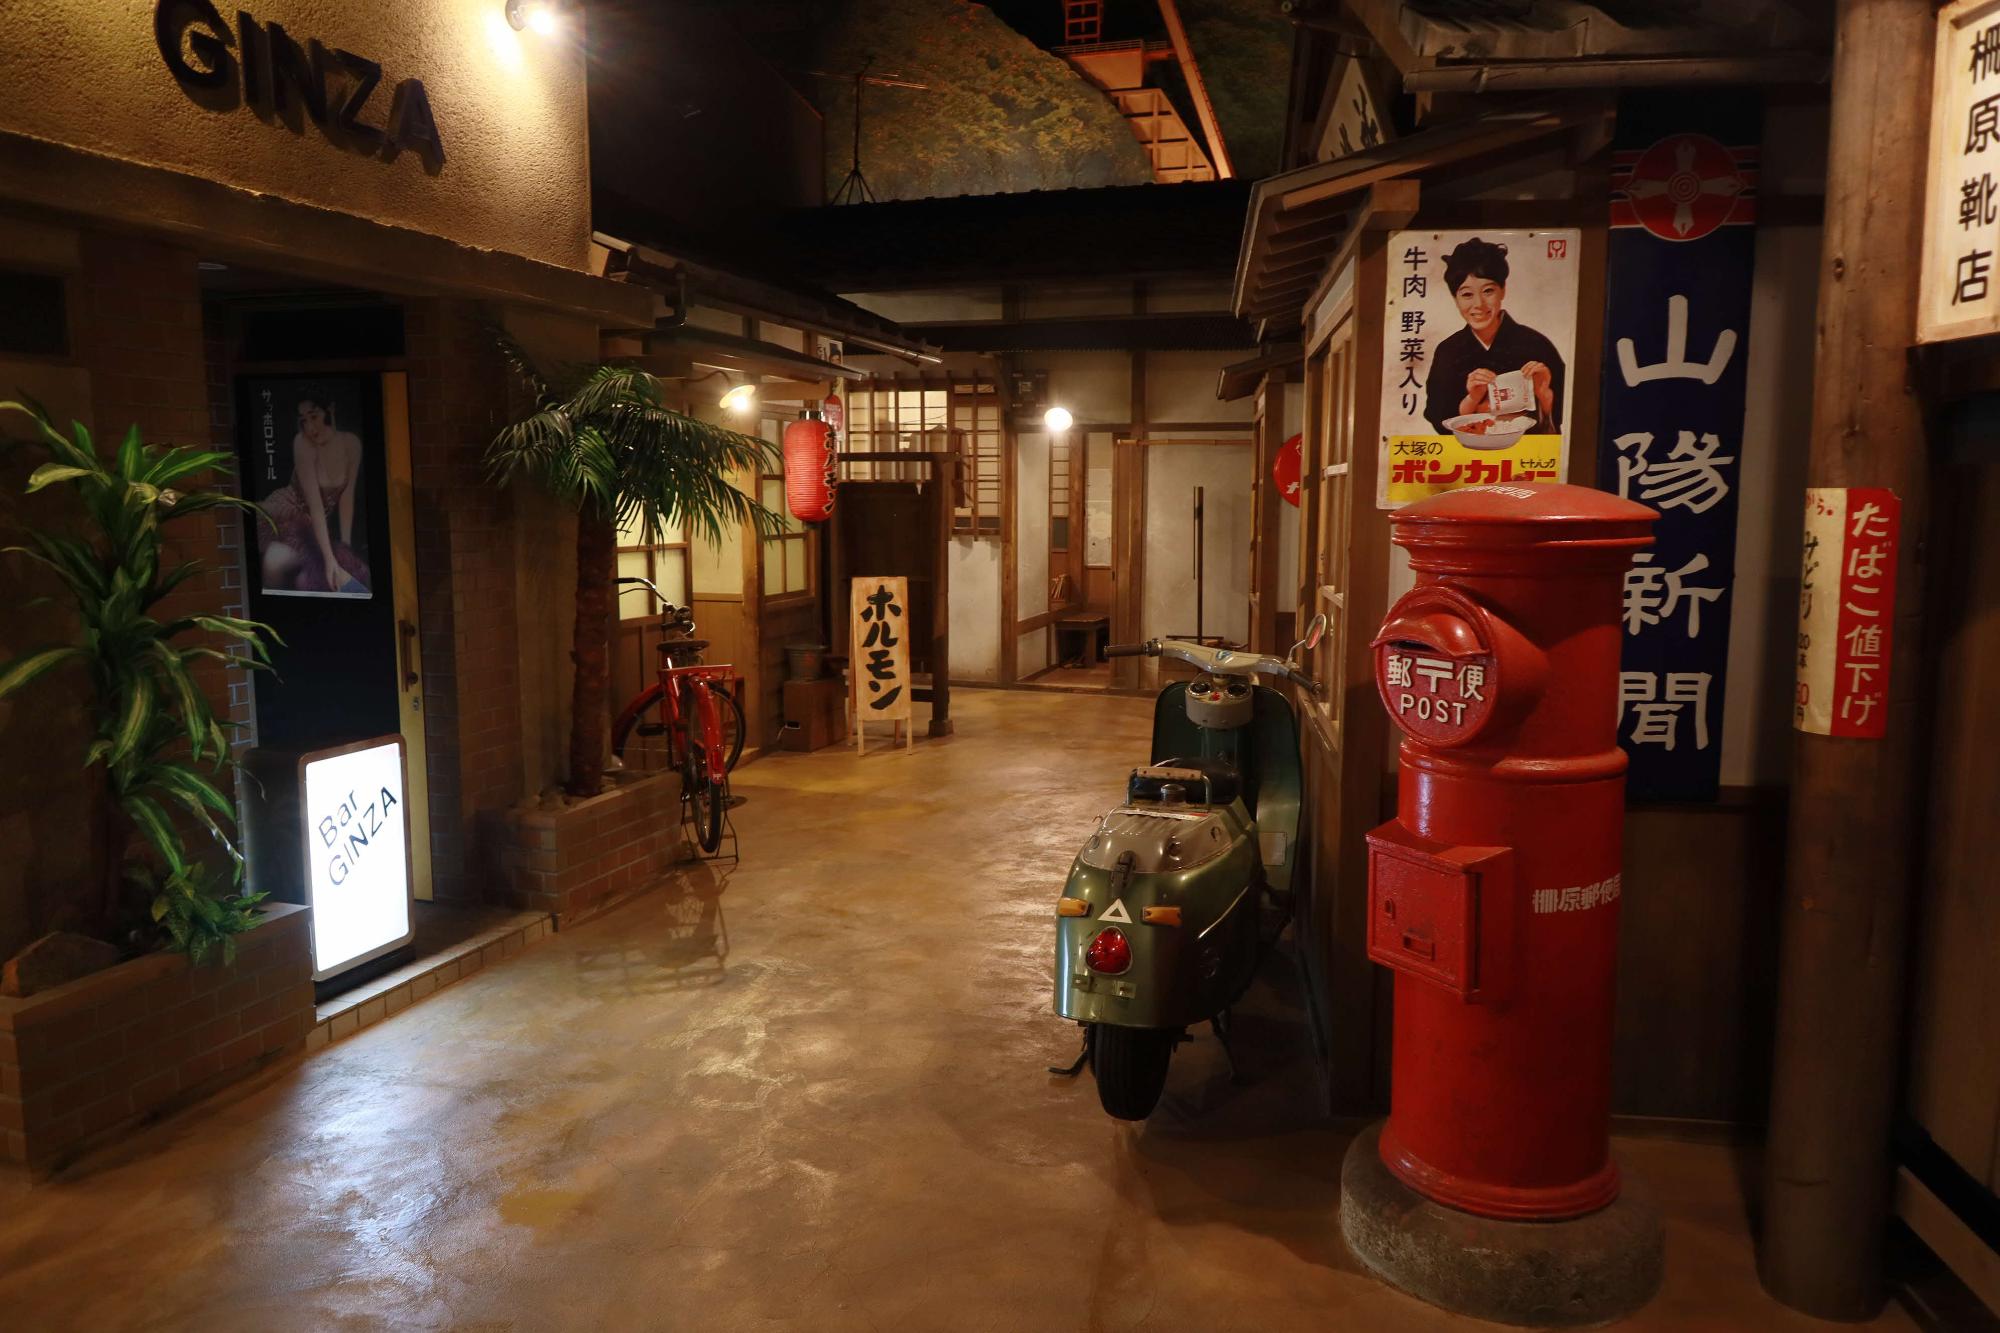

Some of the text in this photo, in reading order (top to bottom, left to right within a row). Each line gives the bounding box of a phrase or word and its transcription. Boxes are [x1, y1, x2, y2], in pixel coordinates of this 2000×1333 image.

[155, 0, 446, 172] GINZA
[1399, 246, 1428, 416] 牛肉 野菜入り
[1392, 460, 1557, 484] ボンカレー
[1394, 441, 1444, 457] 大塚の
[1612, 294, 1738, 751] 山陽新聞
[860, 585, 902, 710] ホルモン
[1841, 502, 1892, 727] たばこ値下げ
[1400, 694, 1467, 725] POST
[318, 789, 357, 848] Bar
[329, 786, 397, 885] GINZA
